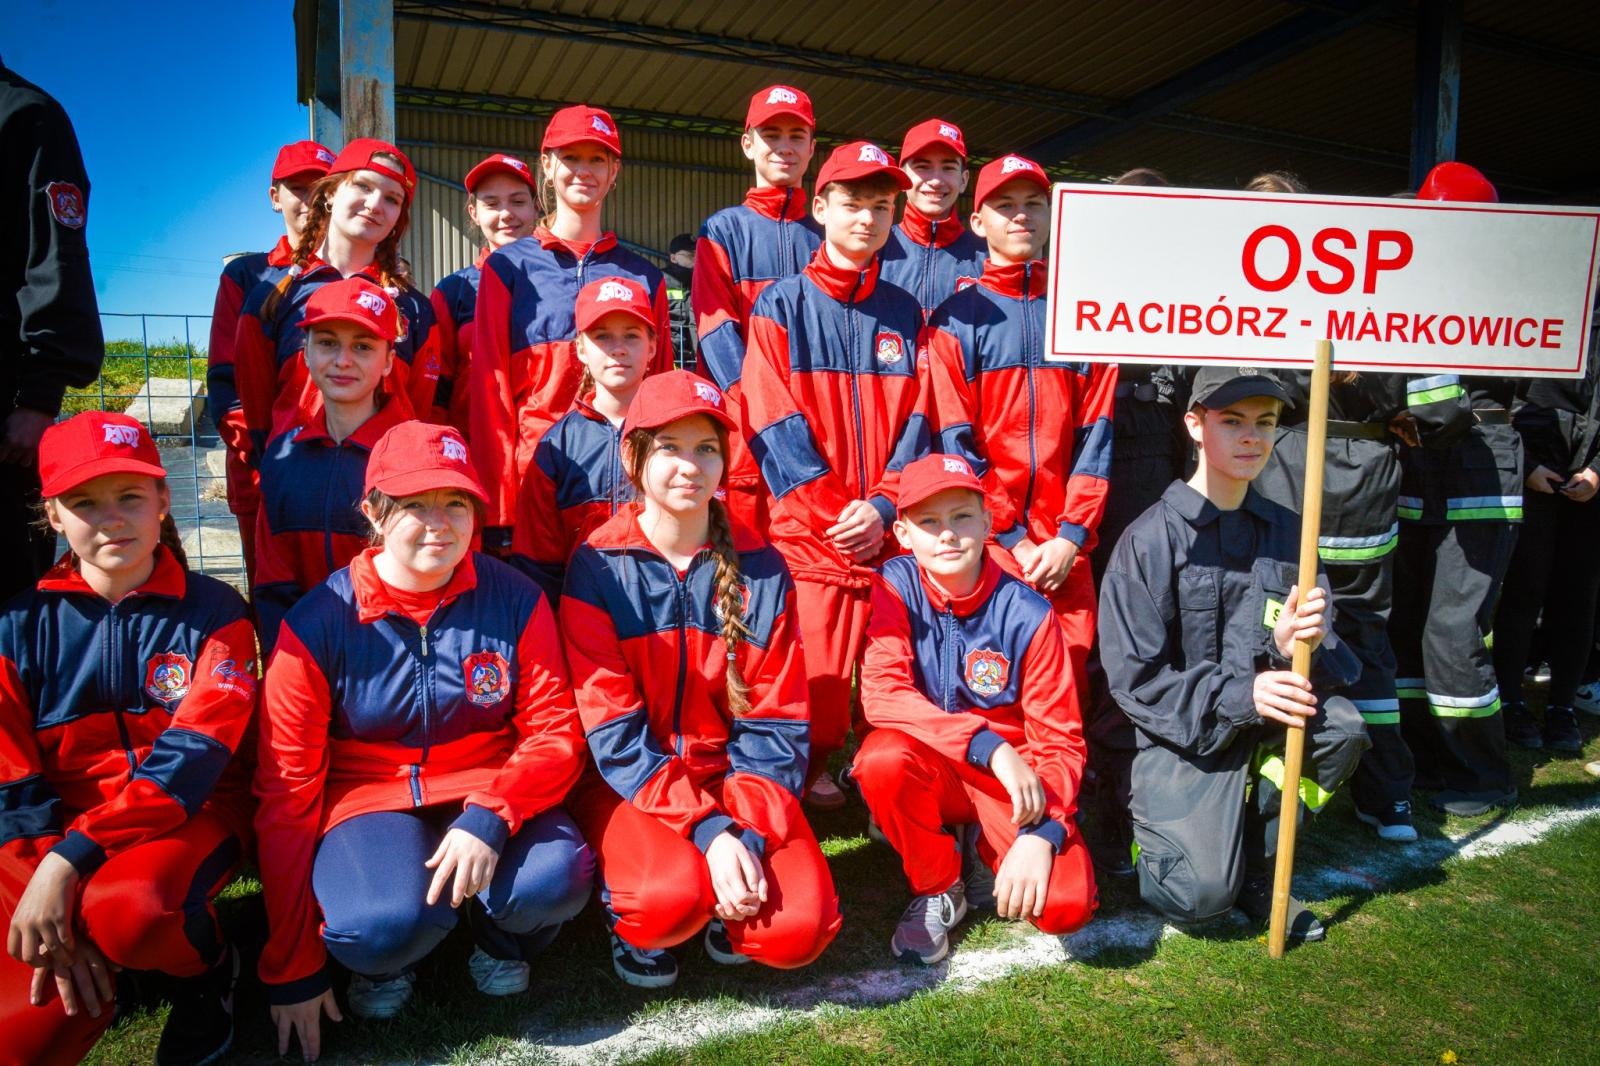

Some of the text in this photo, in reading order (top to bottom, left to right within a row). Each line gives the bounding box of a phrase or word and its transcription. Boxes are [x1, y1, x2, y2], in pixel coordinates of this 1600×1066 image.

[1242, 224, 1413, 294] OSP
[356, 290, 387, 316] MDP
[1076, 296, 1287, 338] RACIBÓRZ
[1327, 310, 1563, 348] MARKOWICE
[102, 423, 139, 449] MDP
